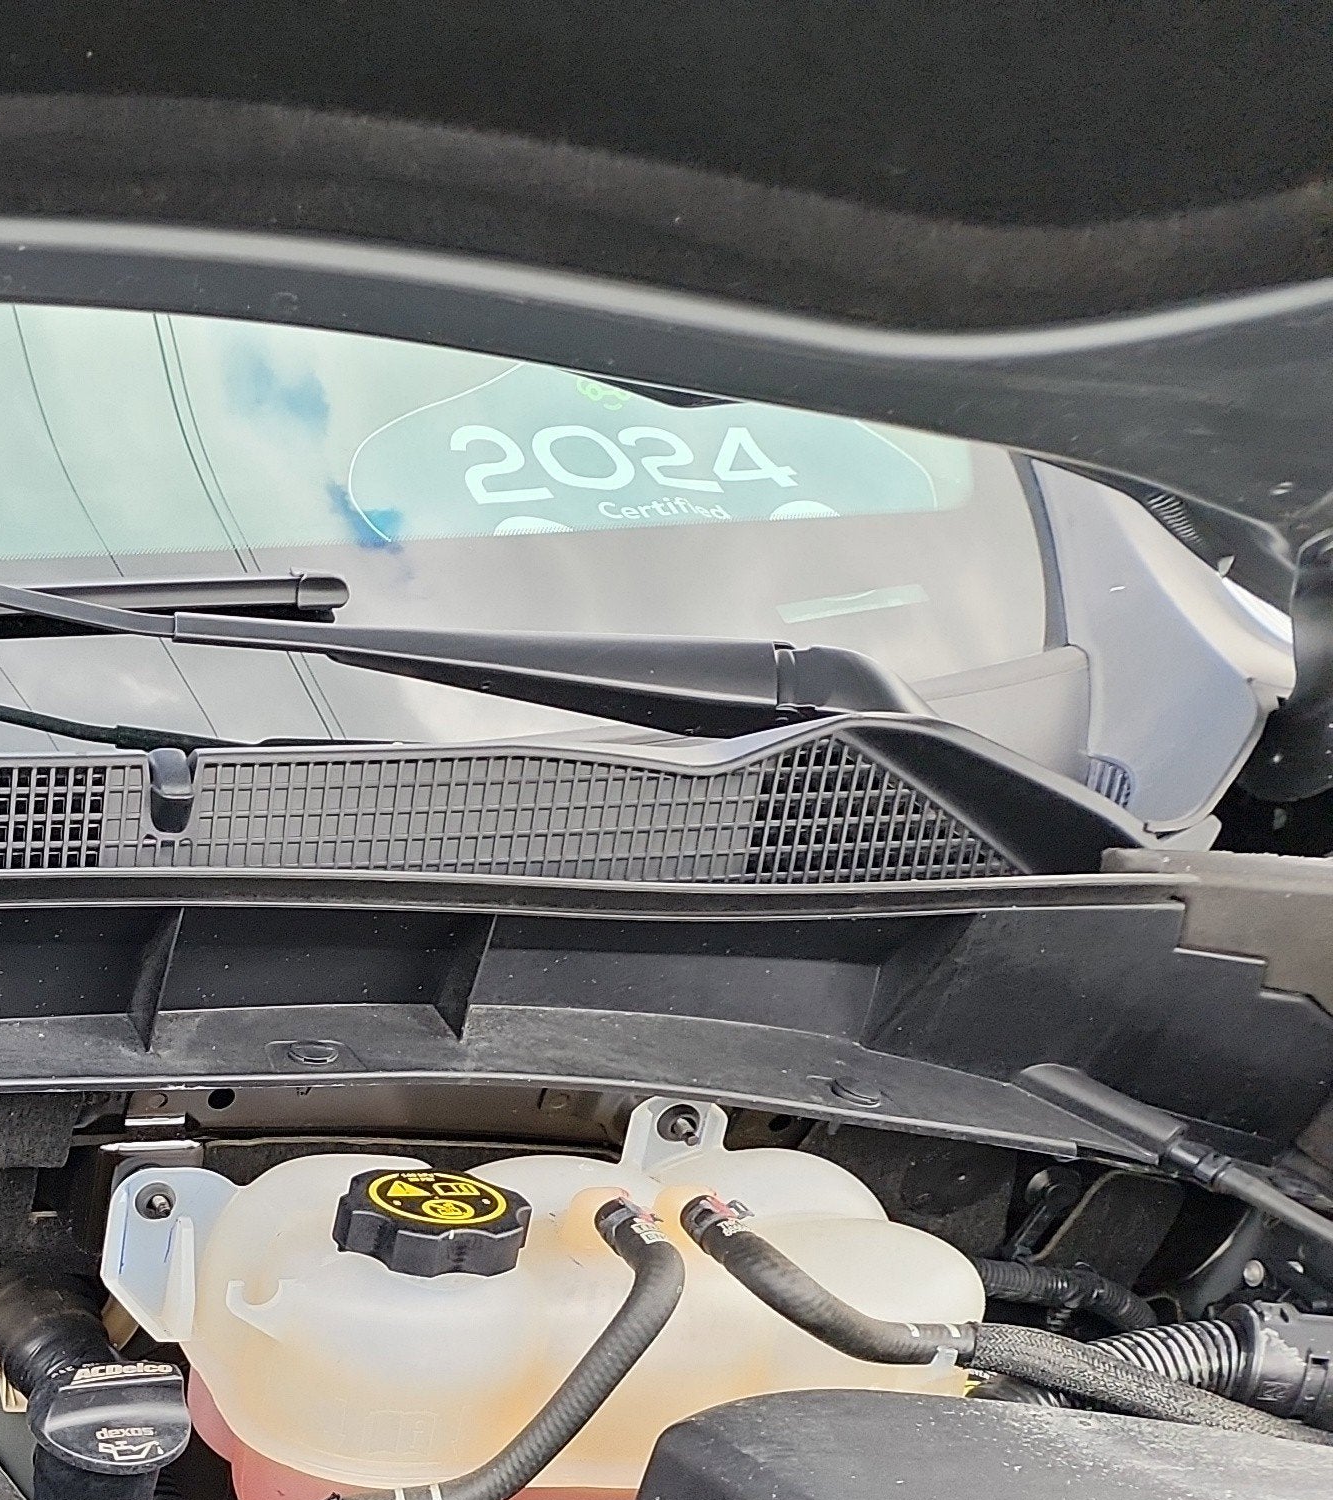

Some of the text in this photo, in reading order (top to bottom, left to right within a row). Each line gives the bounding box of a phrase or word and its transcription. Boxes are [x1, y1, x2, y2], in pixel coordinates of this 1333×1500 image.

[450, 425, 799, 504] 2024
[597, 496, 731, 520] Certified
[72, 1363, 173, 1380] ACDelco
[95, 1427, 154, 1440] dexos
